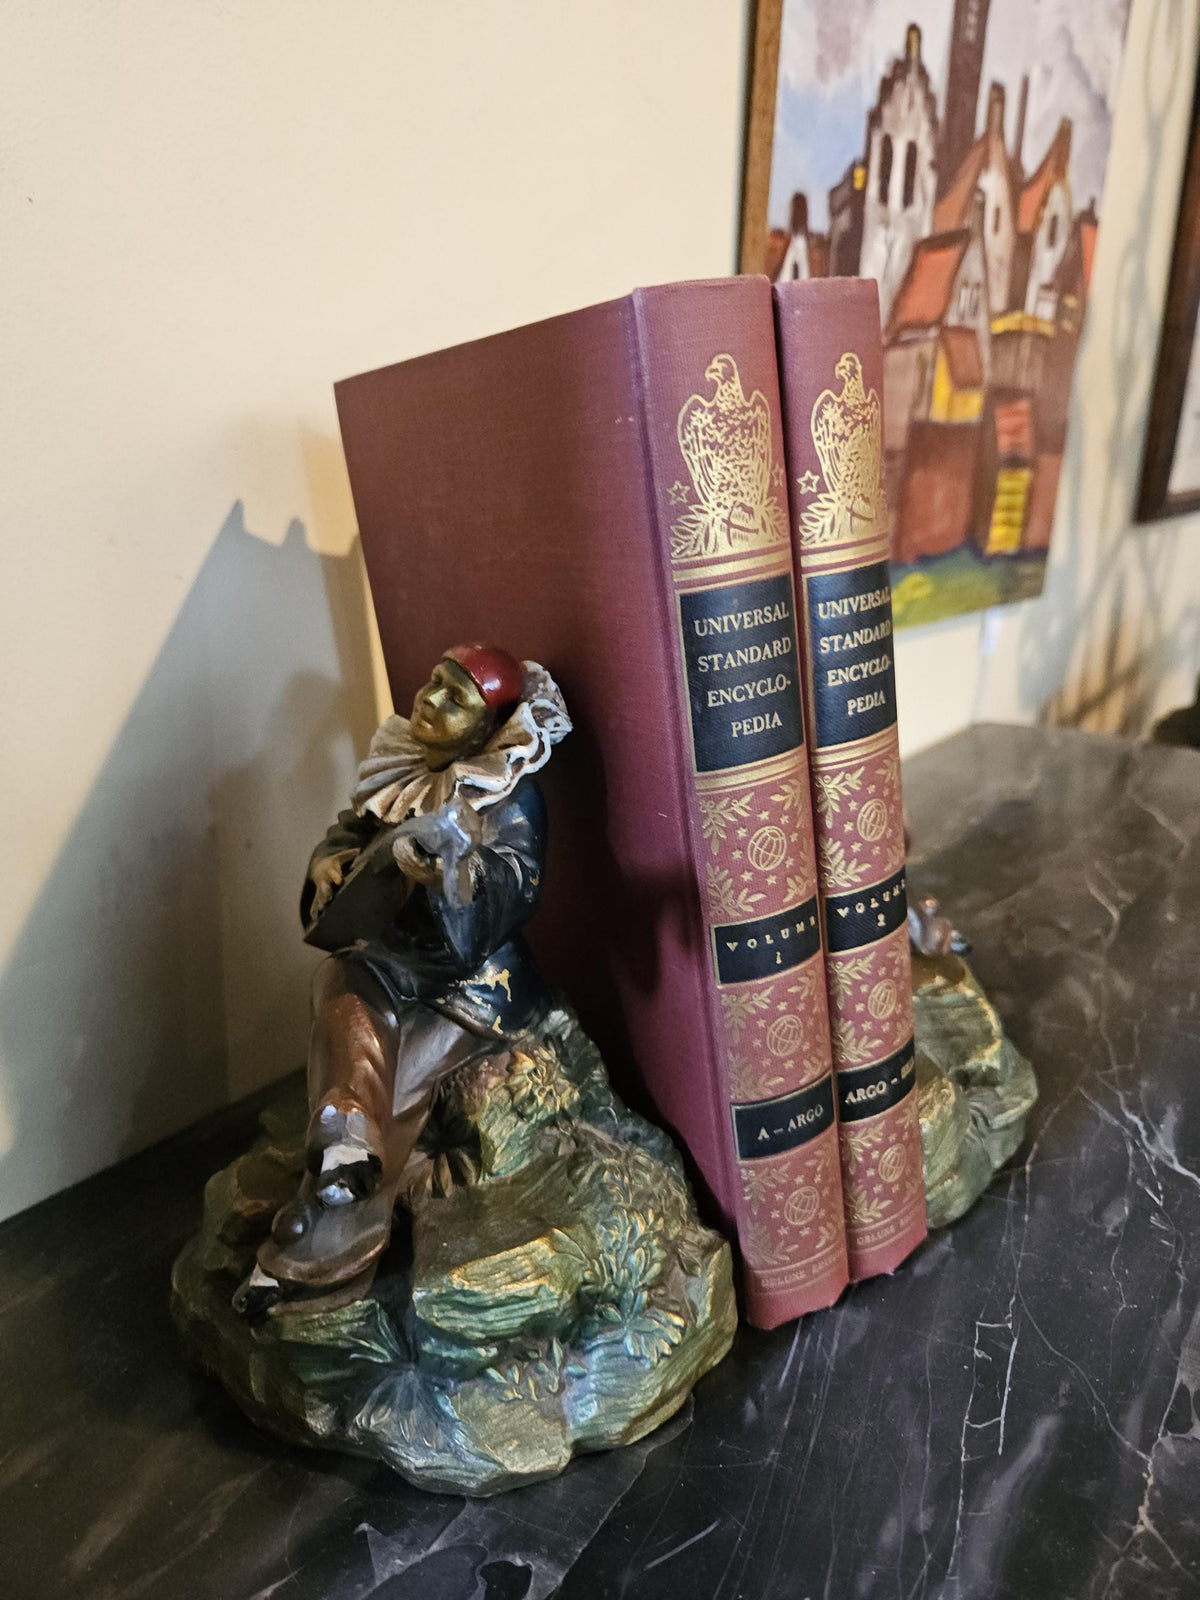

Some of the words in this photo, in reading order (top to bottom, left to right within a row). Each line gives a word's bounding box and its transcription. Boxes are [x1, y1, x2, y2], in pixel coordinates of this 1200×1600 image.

[694, 601, 789, 636] UNIVERSAL
[818, 586, 890, 619] UNIVERSAL
[820, 620, 891, 653] STANDARD
[698, 637, 791, 672] STANDARD
[827, 654, 891, 687] ENCYCLO-
[707, 673, 791, 707] ENCYCLO-
[847, 690, 886, 716] PEDIA
[731, 712, 782, 738] PEDIA
[877, 913, 886, 927] 2
[774, 951, 782, 965] 1
[844, 1080, 887, 1105] ARGO
[757, 1126, 770, 1141] A
[788, 1104, 824, 1133] ARGO
